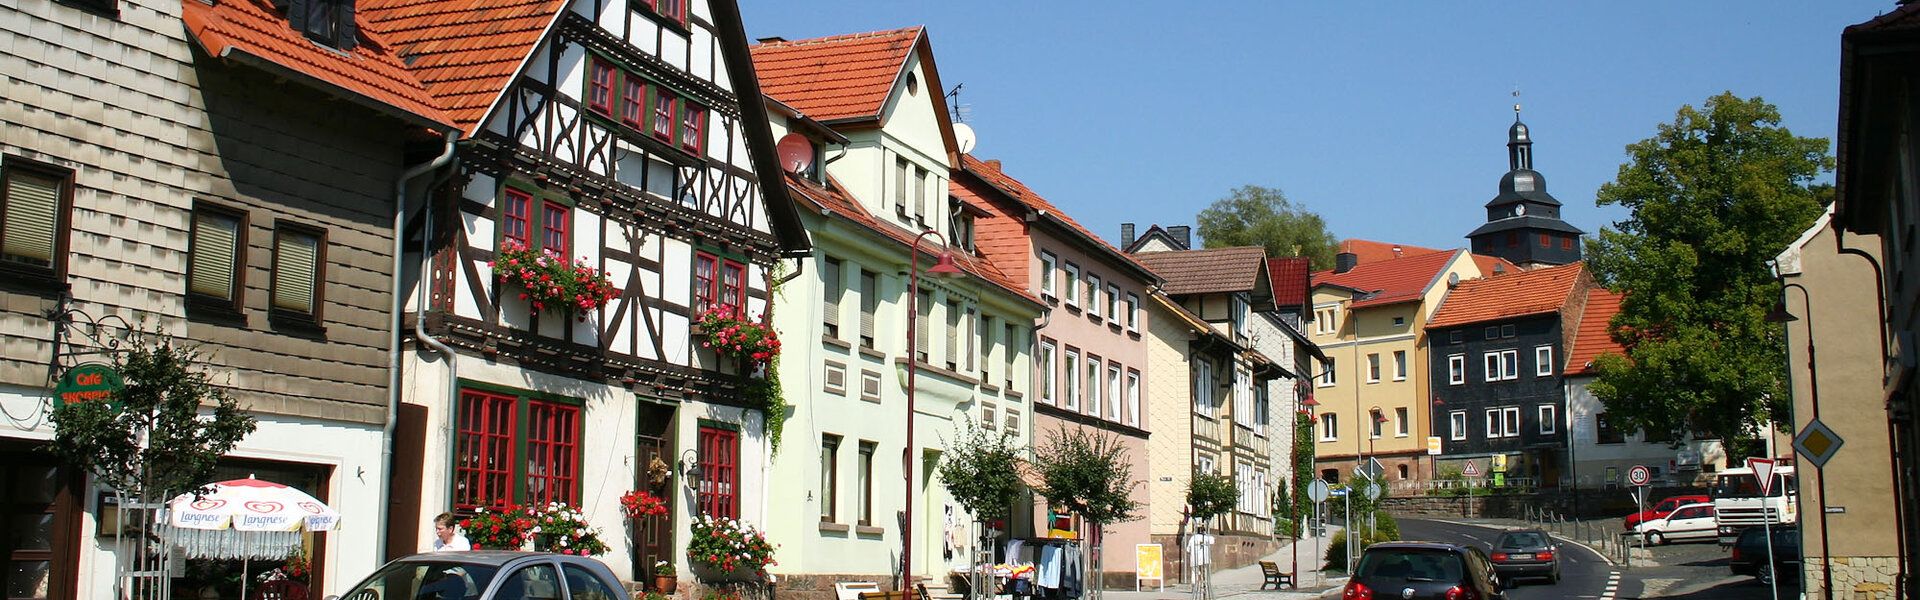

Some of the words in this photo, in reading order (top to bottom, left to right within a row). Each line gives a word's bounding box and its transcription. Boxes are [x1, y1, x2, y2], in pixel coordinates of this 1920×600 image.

[76, 372, 103, 386] Café
[1633, 470, 1645, 480] 30
[180, 511, 220, 526] Langnese
[243, 514, 288, 529] Langnese
